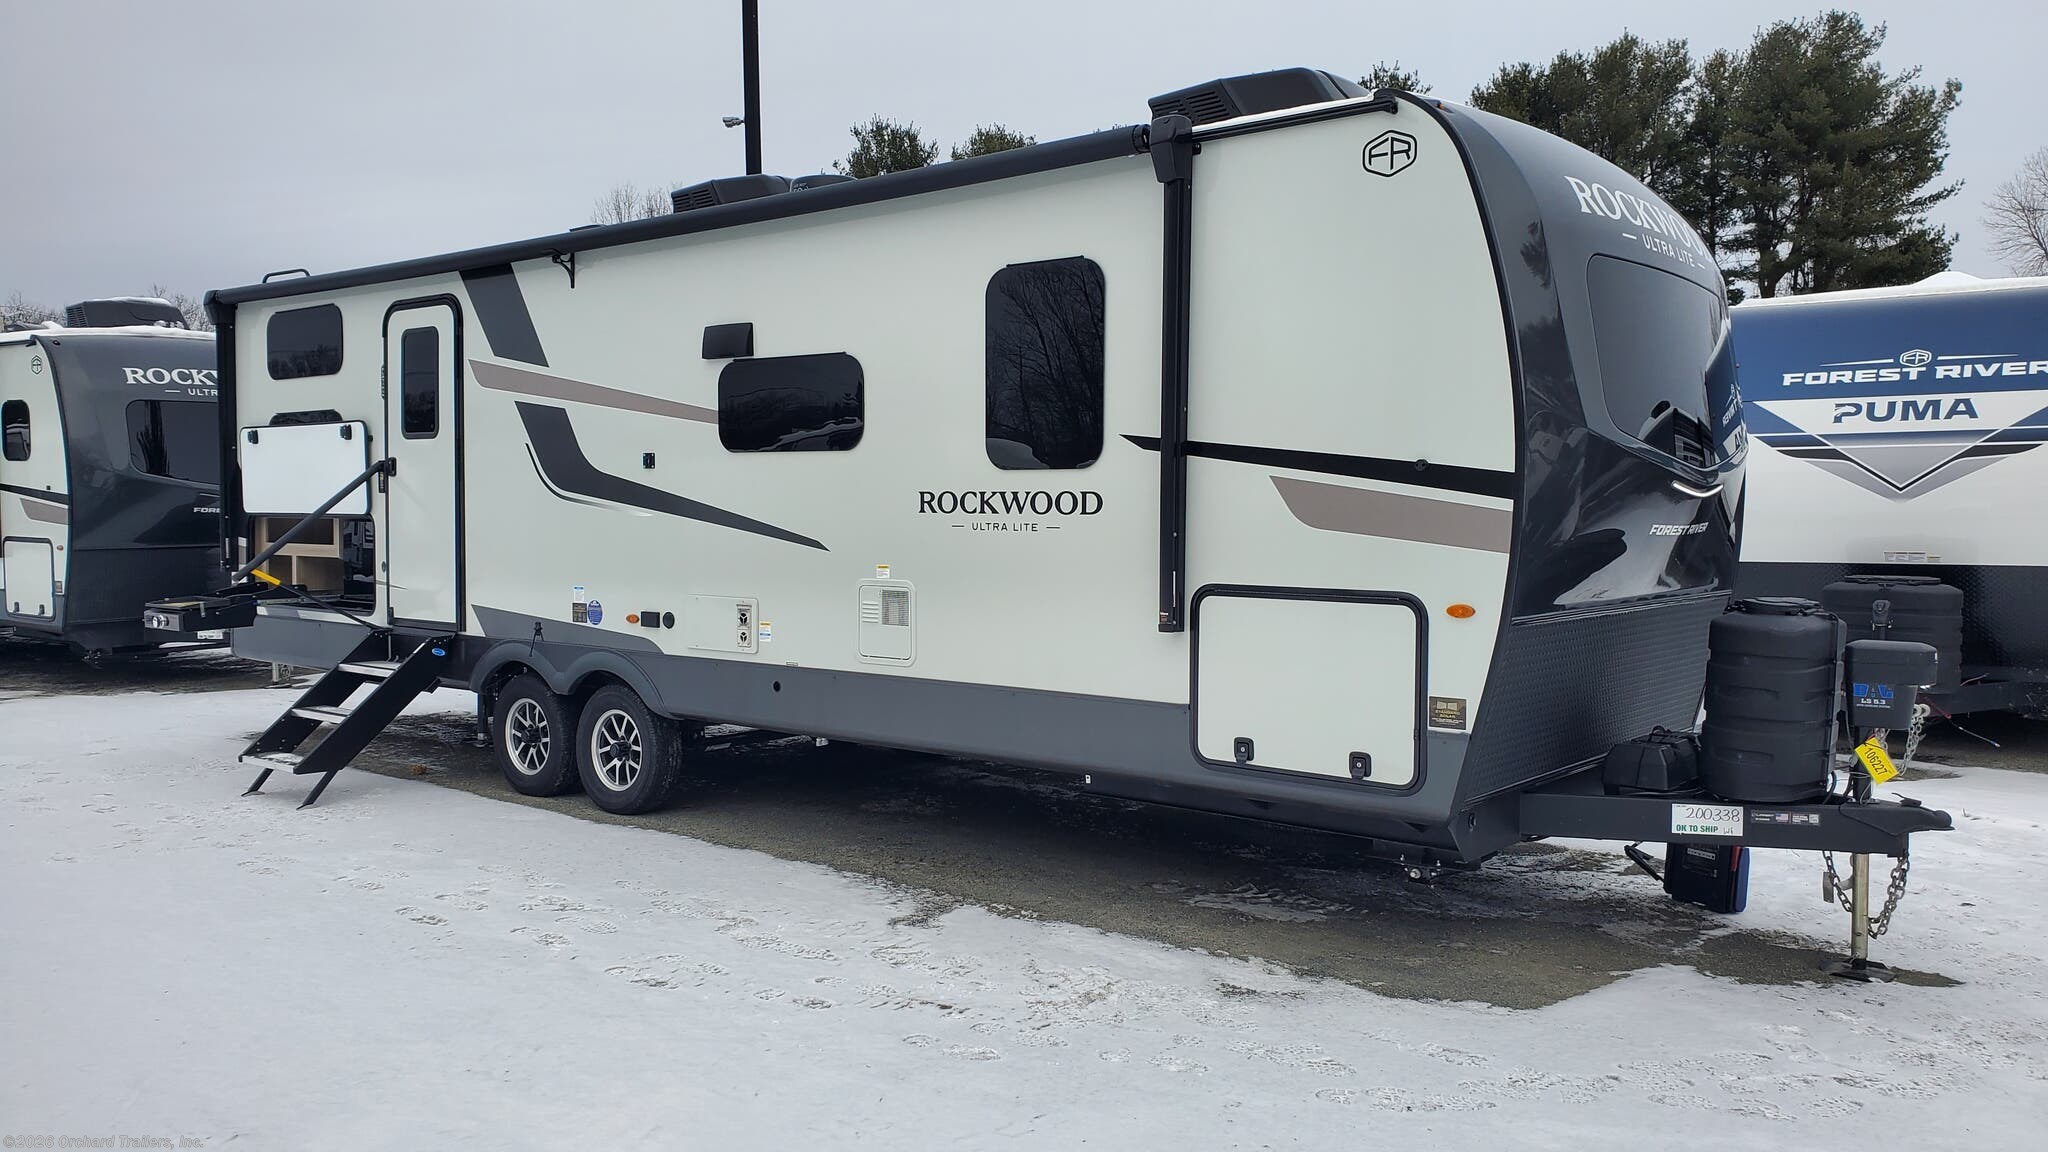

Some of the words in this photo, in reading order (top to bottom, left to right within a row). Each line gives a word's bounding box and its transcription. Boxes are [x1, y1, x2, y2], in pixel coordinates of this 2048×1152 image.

[1641, 234, 1676, 259] ULTRA
[1676, 247, 1696, 267] LITE
[1782, 367, 1927, 386] FOREST
[1935, 360, 2048, 380] RIVER
[1832, 398, 1979, 424] PUMA
[918, 490, 1104, 516] ROCKWOOD
[971, 522, 1008, 532] ULTRA
[1013, 523, 1039, 532] LITE
[1649, 524, 1690, 536] FOREST
[1864, 747, 1888, 776] 106227
[1684, 807, 1740, 823] 200338
[1676, 824, 1688, 832] OK
[1688, 824, 1698, 832] TO
[1700, 825, 1719, 833] SHIP
